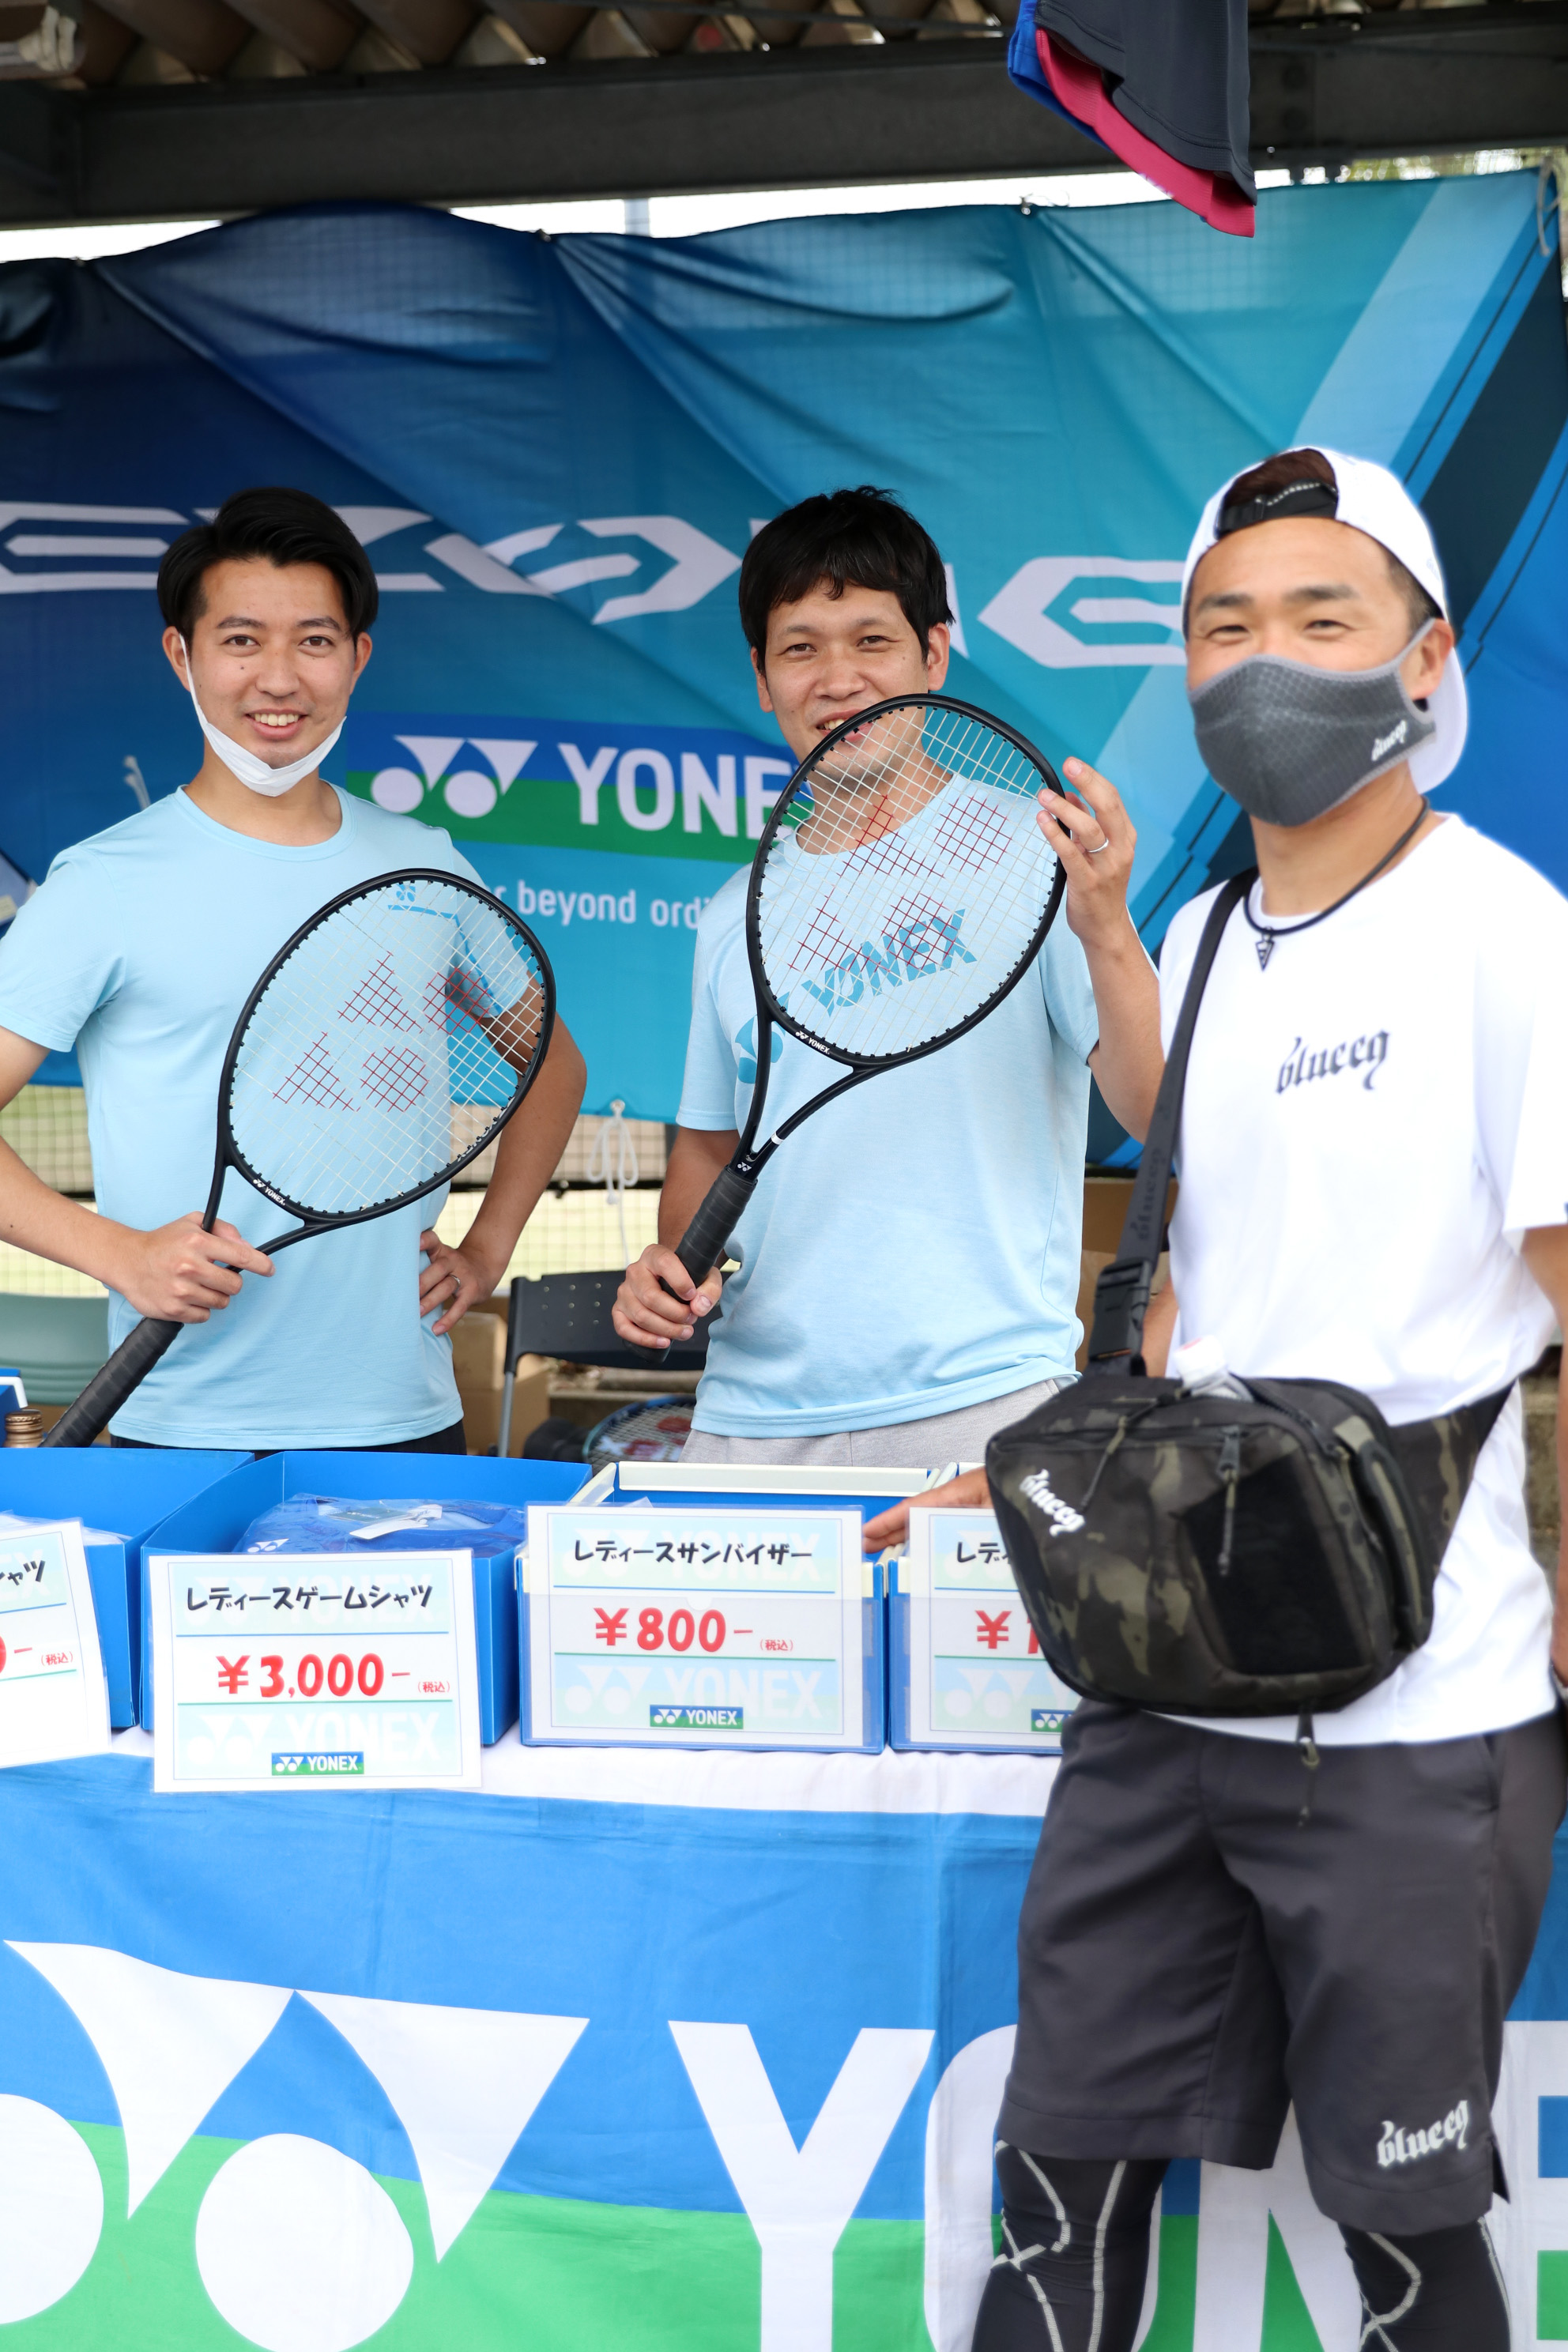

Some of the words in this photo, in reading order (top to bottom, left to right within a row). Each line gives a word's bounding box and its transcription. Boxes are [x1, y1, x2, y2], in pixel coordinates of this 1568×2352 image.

[557, 742, 801, 842] YONE
[518, 879, 636, 926] beyond
[801, 908, 978, 1017] YONEX
[808, 1037, 830, 1055] YONEX
[264, 1186, 285, 1205] YONEX
[574, 1539, 812, 1566] レディースサンバイザー
[660, 1528, 822, 1581] YONEX
[187, 1584, 433, 1611] レディースゲームシャツ
[277, 1573, 438, 1625] YONEX
[664, 1666, 824, 1720] YONEX
[285, 1709, 443, 1762] YONEX
[685, 1709, 738, 1726] YONEX
[307, 1755, 359, 1772] YONEX
